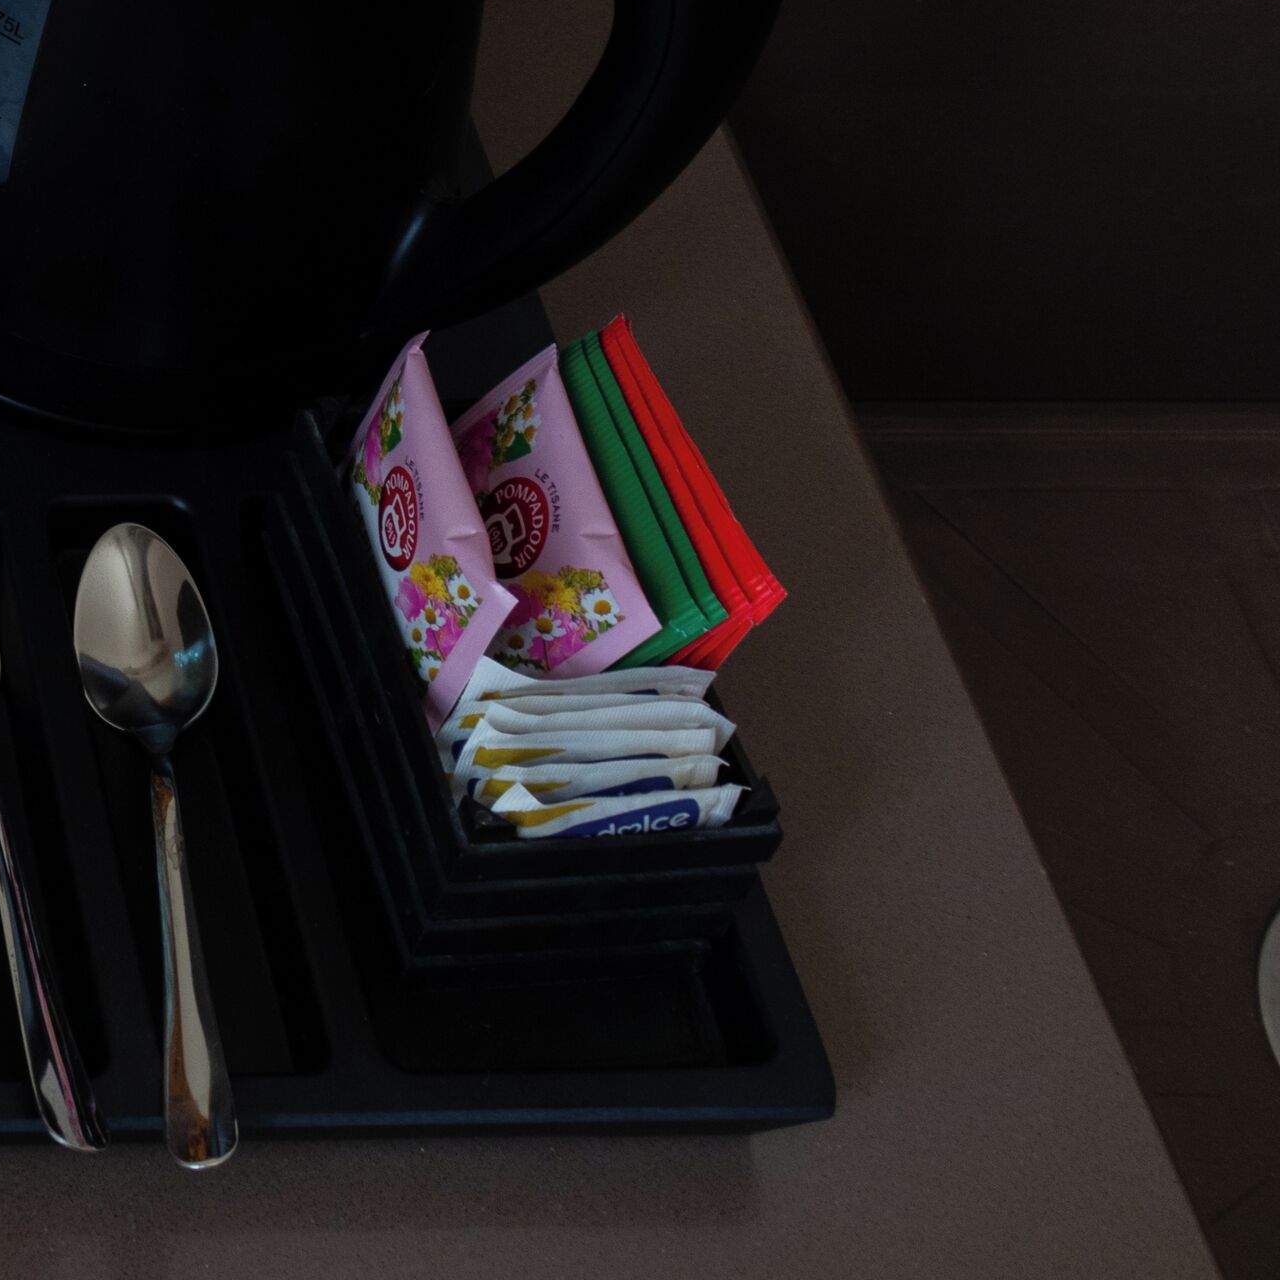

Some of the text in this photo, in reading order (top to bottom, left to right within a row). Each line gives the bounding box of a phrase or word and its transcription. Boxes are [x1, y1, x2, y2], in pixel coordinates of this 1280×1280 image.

[385, 473, 416, 561] POMPADOUR
[495, 483, 544, 569] POMPADOUR
[534, 468, 561, 533] LE TISANE
